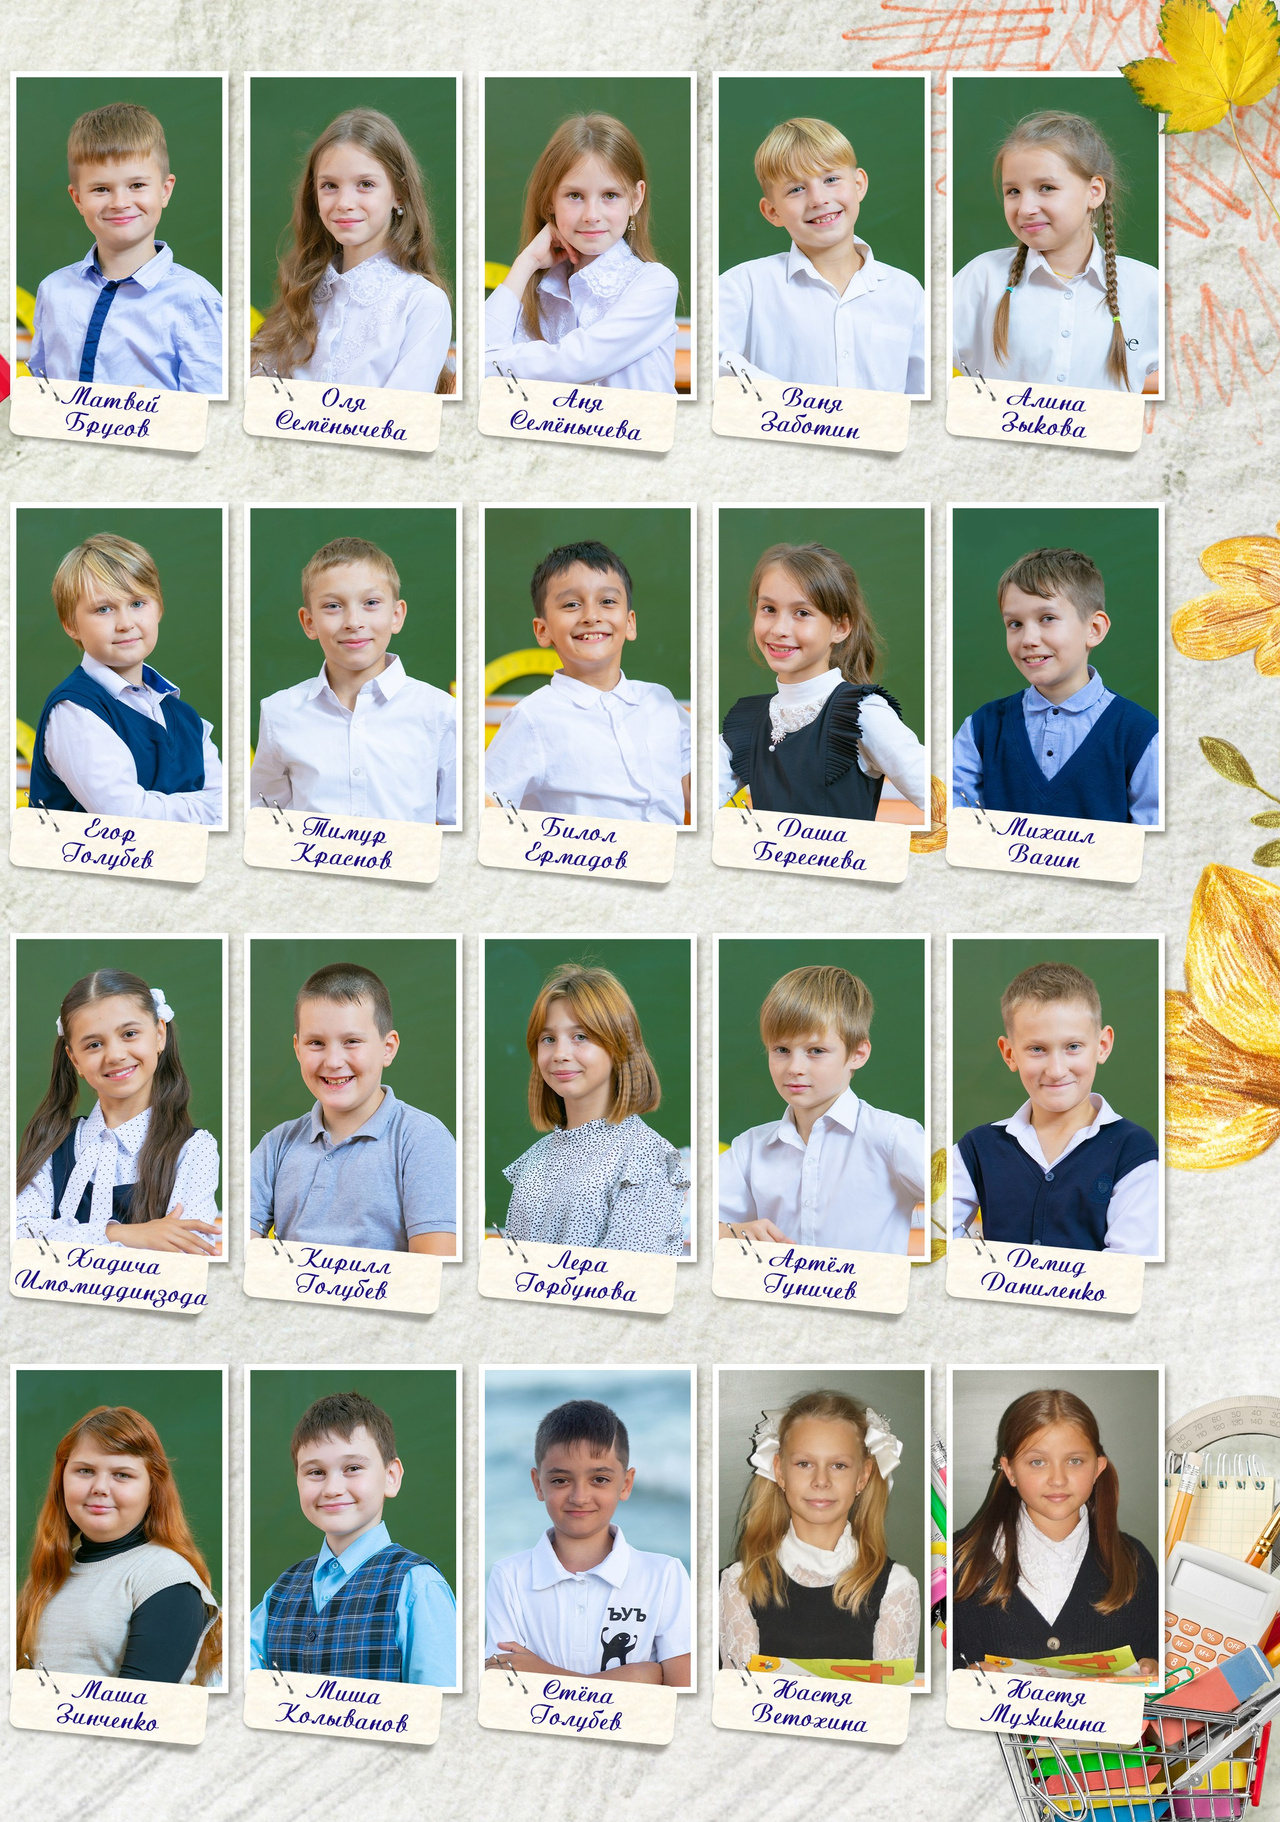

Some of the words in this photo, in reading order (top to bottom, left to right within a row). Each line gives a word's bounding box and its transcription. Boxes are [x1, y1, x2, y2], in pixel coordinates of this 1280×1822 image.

[1211, 1415, 1222, 1424] 60
[1231, 1418, 1244, 1427] 130
[1193, 1423, 1204, 1432] 70
[1212, 1422, 1226, 1432] 120
[1180, 1439, 1193, 1451] 100
[607, 1606, 647, 1622] ЪУЪ
[1183, 1623, 1194, 1633] CE
[1207, 1632, 1216, 1642] %
[1226, 1641, 1242, 1651] OFF
[1197, 1649, 1210, 1658] M+
[1170, 1657, 1179, 1667] 8
